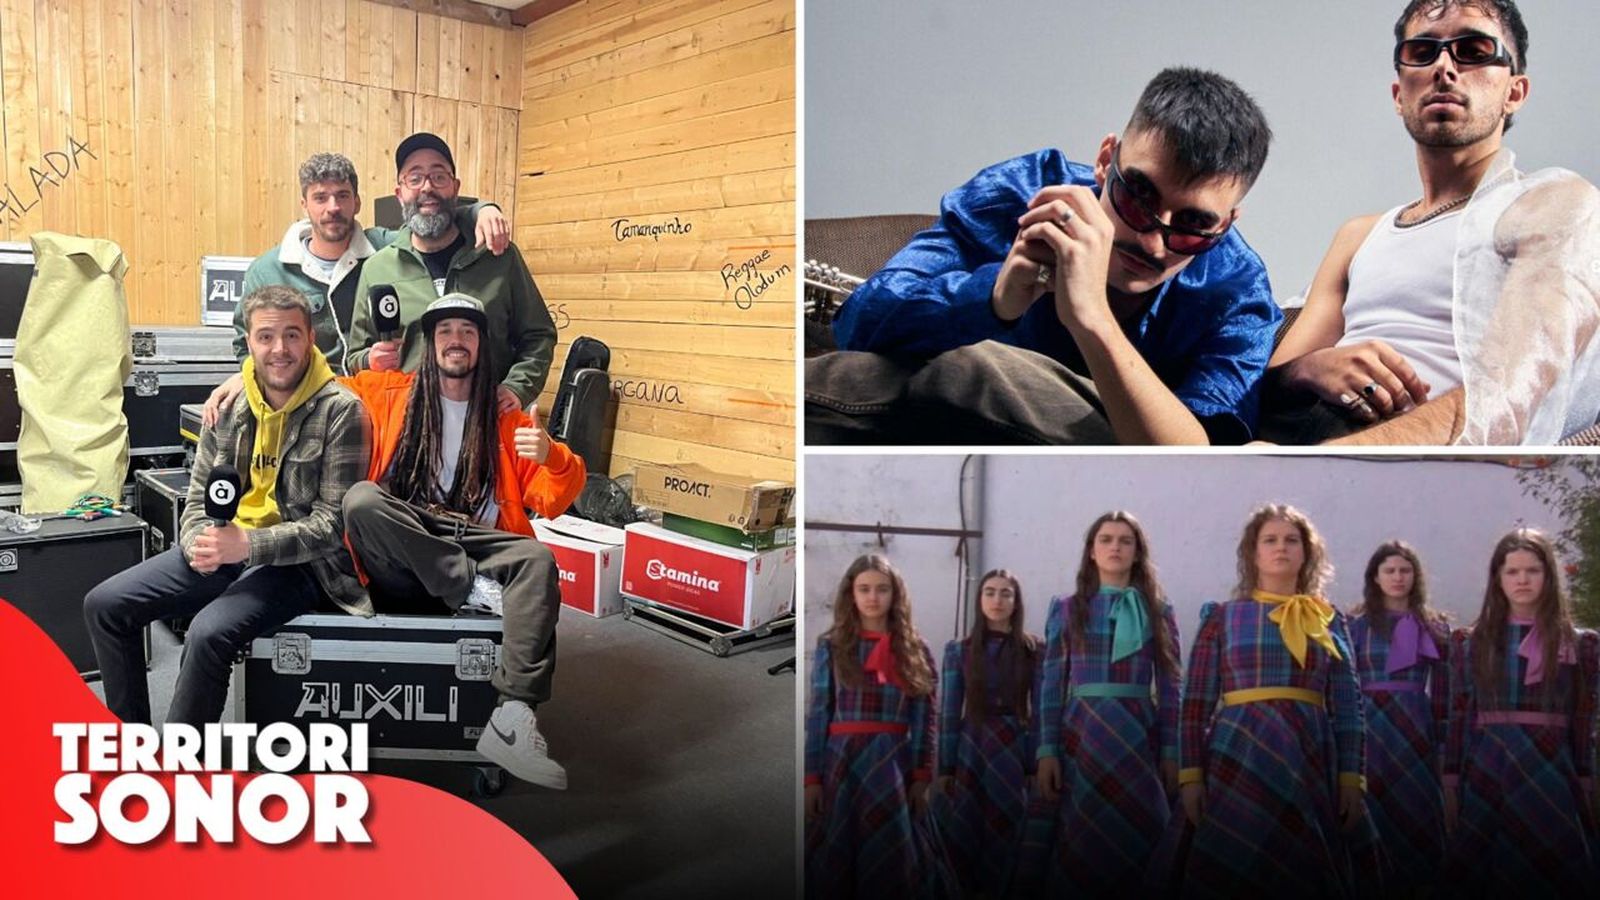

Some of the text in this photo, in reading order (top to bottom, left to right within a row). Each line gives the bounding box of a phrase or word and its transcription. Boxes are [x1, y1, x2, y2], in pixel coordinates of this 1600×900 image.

[720, 249, 771, 290] Reggae
[734, 263, 791, 310] Olodum
[646, 559, 719, 592] Stamina
[293, 682, 458, 722] AUXILI
